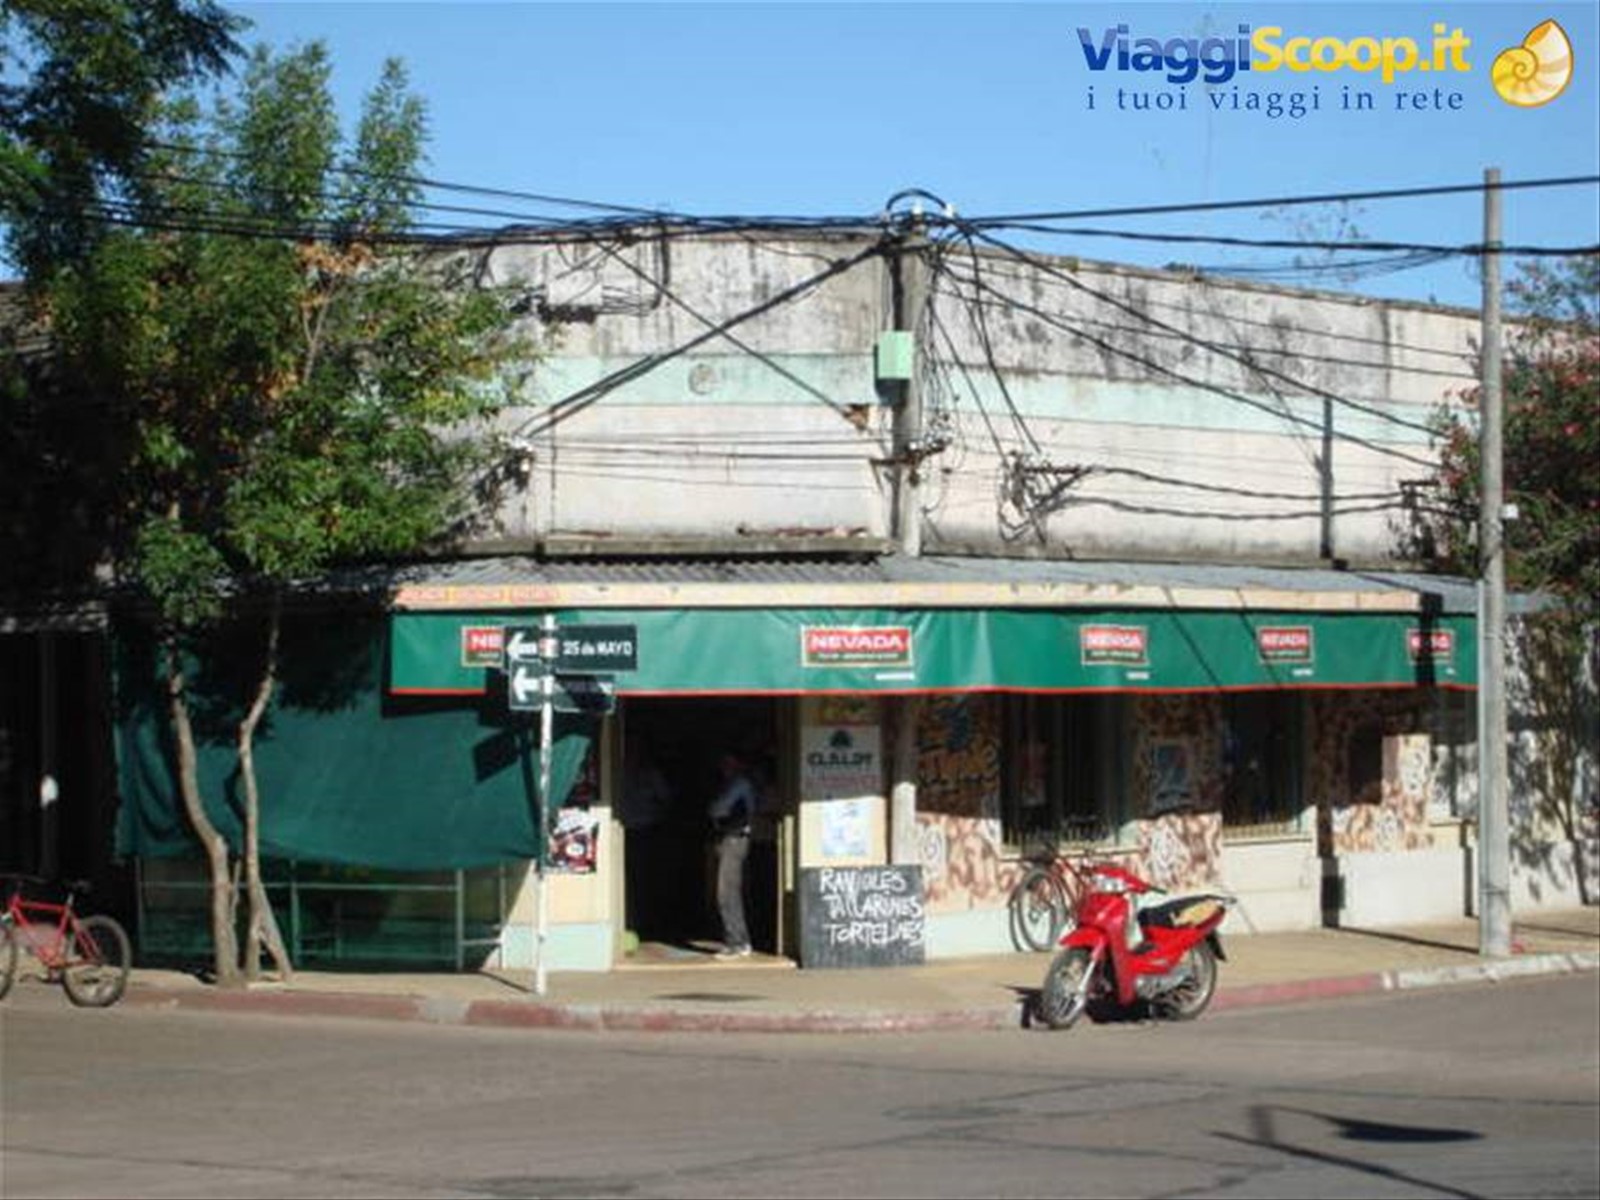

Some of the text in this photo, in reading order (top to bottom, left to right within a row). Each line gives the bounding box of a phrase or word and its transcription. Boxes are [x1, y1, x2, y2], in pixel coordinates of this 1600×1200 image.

[562, 640, 580, 655] 25
[597, 640, 633, 657] MAYO
[809, 635, 905, 651] NEVADA
